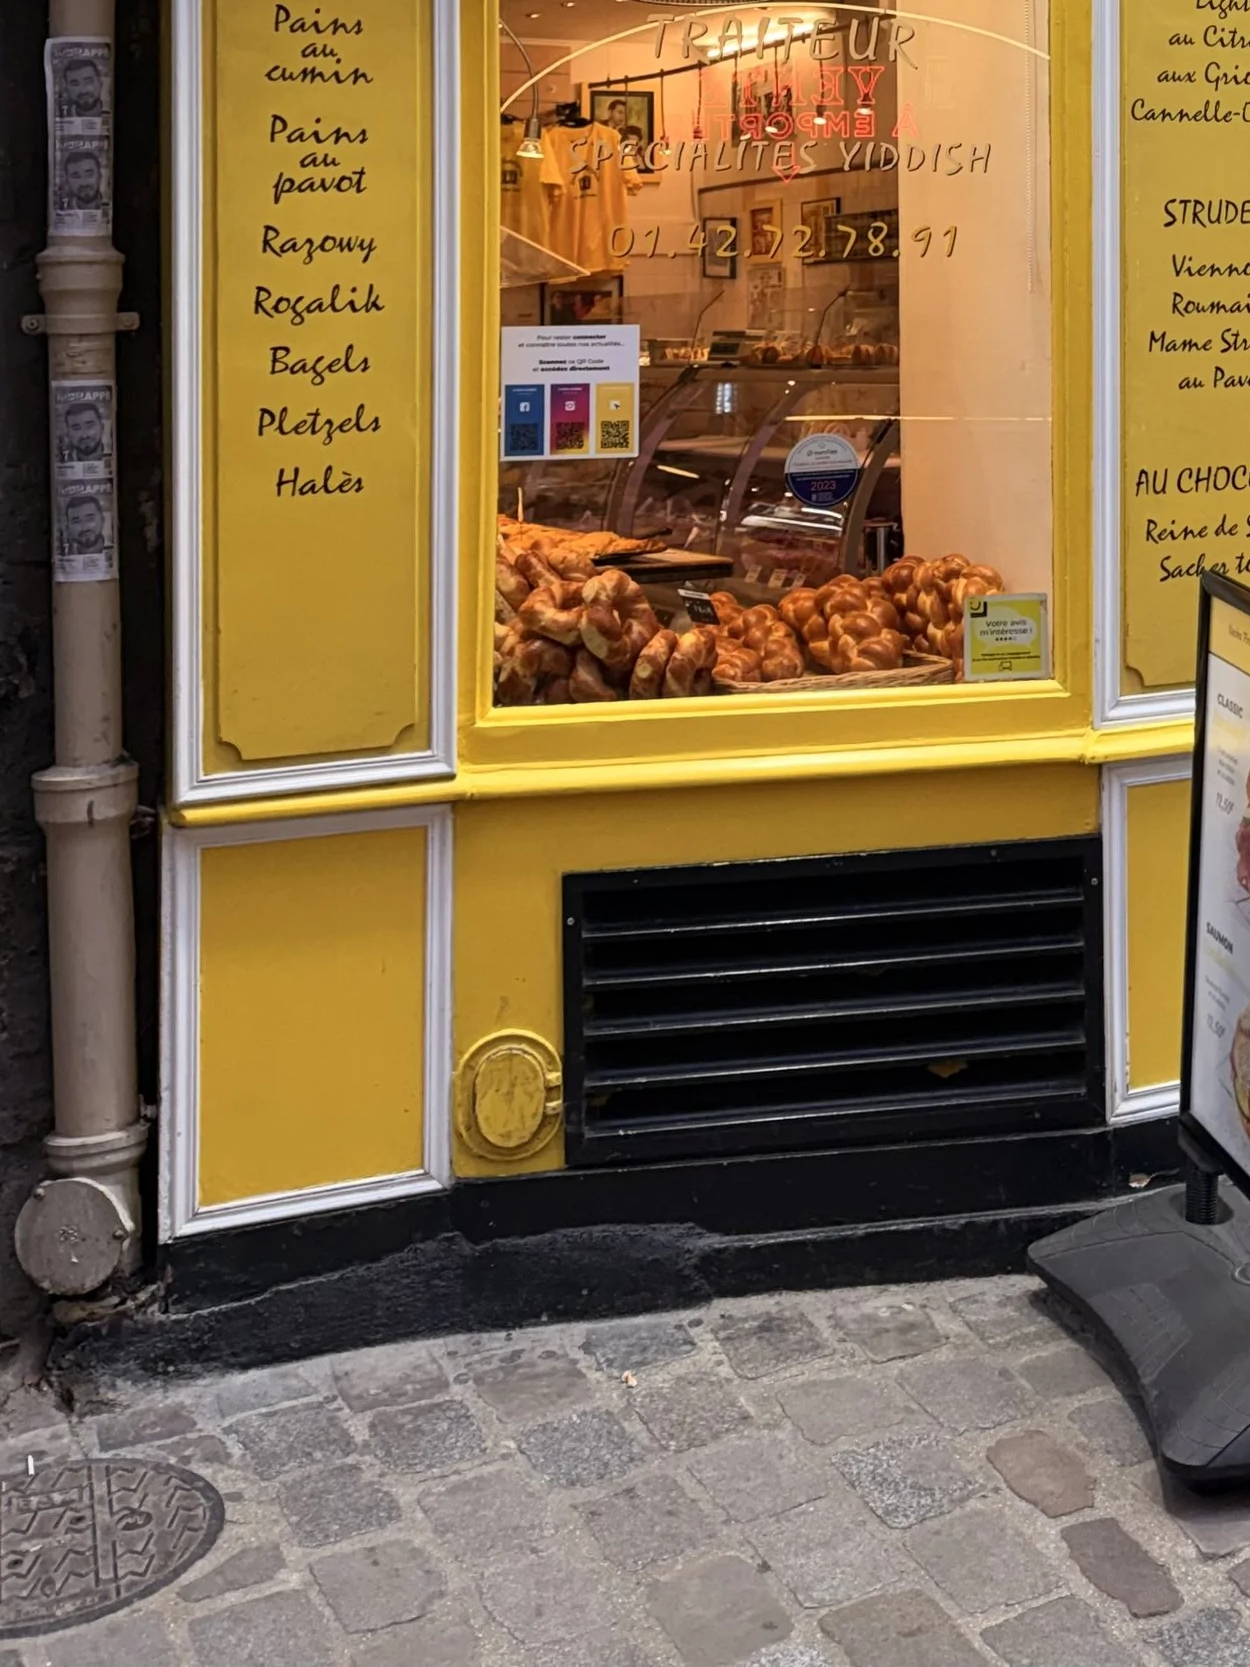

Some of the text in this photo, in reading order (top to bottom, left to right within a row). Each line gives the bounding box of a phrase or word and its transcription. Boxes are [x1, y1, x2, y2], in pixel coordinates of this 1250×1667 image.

[274, 3, 364, 36] Pains
[300, 41, 339, 59] au
[646, 12, 919, 71] TRAITEUR
[1168, 32, 1197, 47] au
[264, 56, 375, 86] cumin
[1156, 68, 1198, 85] aux
[268, 113, 369, 145] Pains
[299, 151, 341, 169] au
[839, 141, 993, 178] YIDDISH
[272, 166, 368, 205] pavot
[261, 224, 378, 266] Razowy
[253, 283, 386, 327] Rogalik
[1148, 329, 1213, 355] Mame
[269, 343, 371, 386] Bagels
[1178, 373, 1206, 390] au
[257, 403, 382, 446] Pletzels
[275, 465, 365, 498] Halès
[810, 480, 837, 491] 2023
[1134, 467, 1169, 497] AU
[1145, 518, 1210, 545] Reine
[1214, 513, 1240, 538] de
[1159, 552, 1230, 583] Sacher
[979, 627, 1028, 637] m'intéresse
[1216, 692, 1244, 720] CLASSIC
